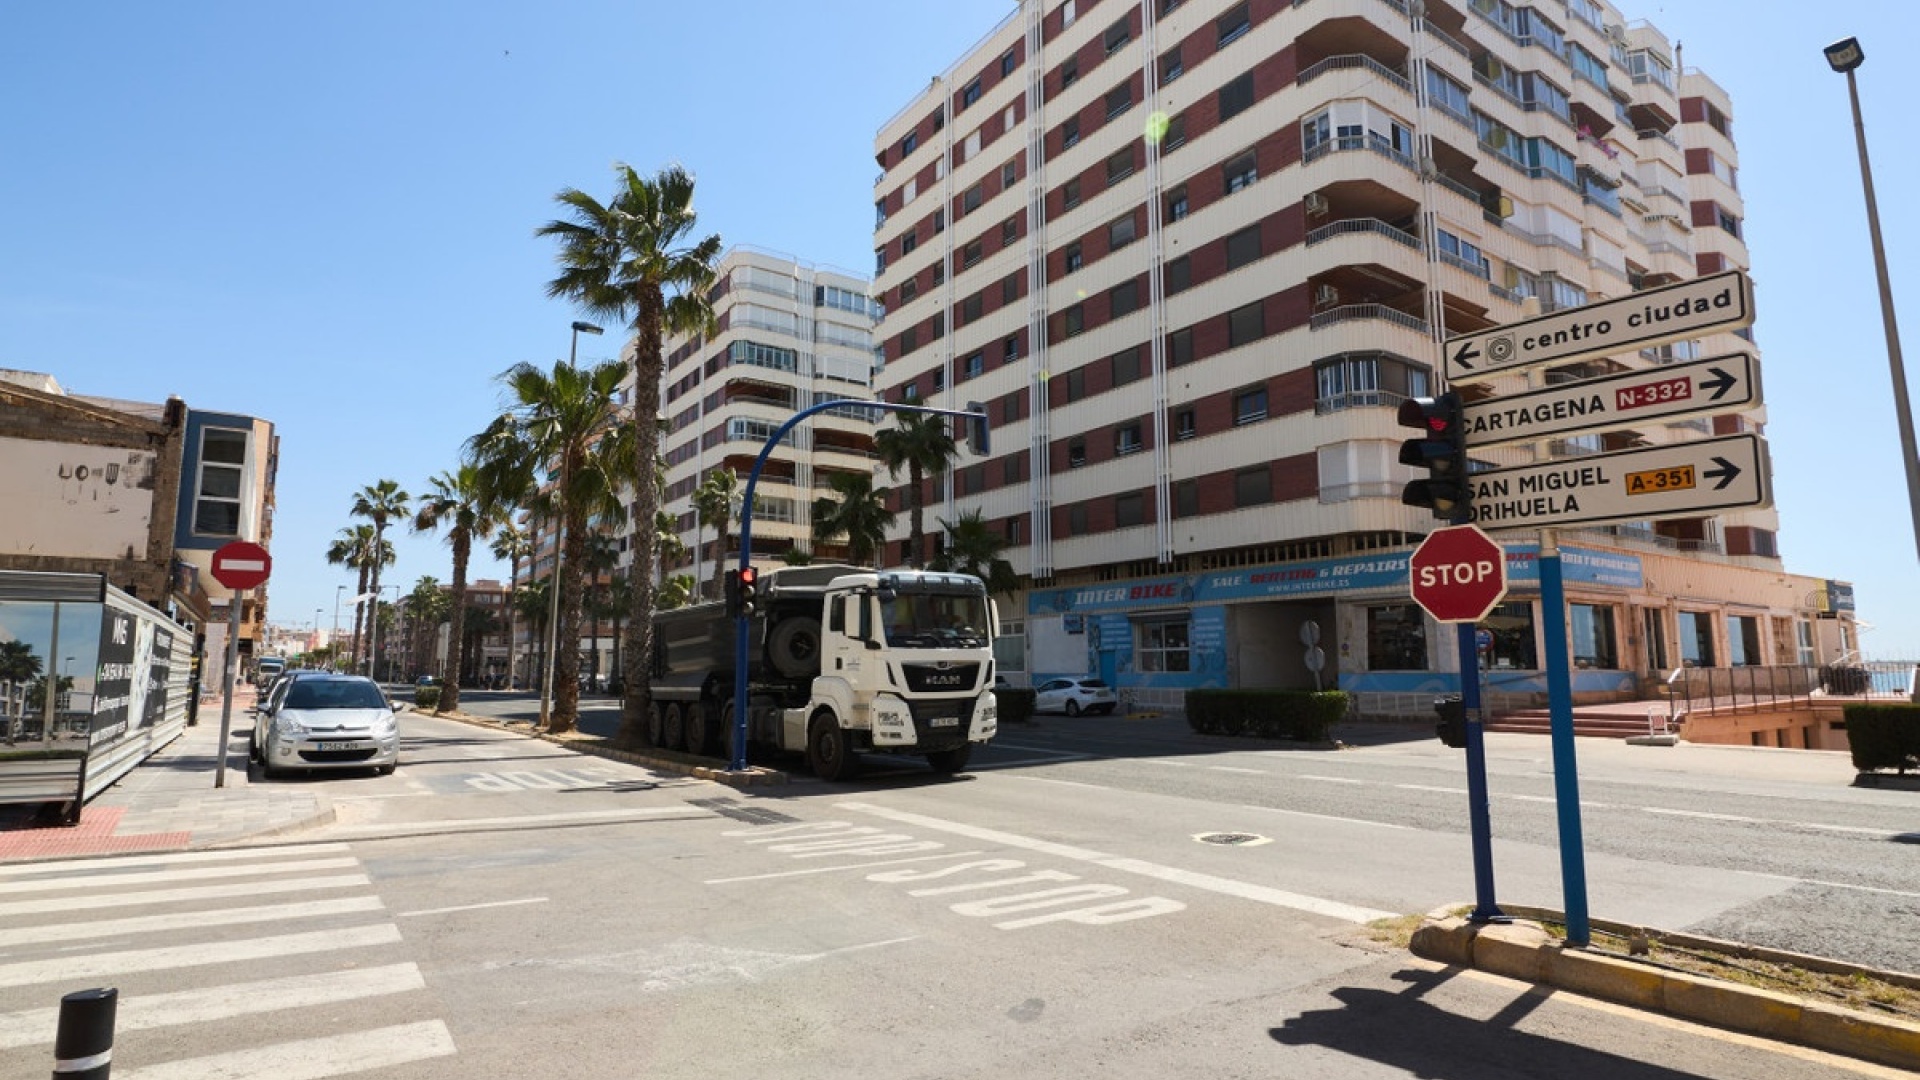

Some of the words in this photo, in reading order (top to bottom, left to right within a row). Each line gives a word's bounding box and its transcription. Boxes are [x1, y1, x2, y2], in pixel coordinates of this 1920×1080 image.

[1523, 321, 1611, 350] centro
[1628, 289, 1732, 327] ciudad
[1464, 395, 1605, 434] CARTAGENA
[1620, 381, 1688, 407] N-332
[1468, 479, 1509, 500] SAN
[1519, 467, 1610, 494] MIGUEL
[1632, 470, 1693, 490] A-351
[1469, 495, 1580, 522] ORIHUELA
[1212, 576, 1242, 588] SALE
[1332, 559, 1407, 576] REPAIRS
[1420, 561, 1494, 587] STOP
[1074, 588, 1127, 605] INTER
[1130, 582, 1178, 600] BIKE
[925, 675, 960, 685] MAN
[720, 821, 945, 858] STOP
[866, 859, 1187, 929] STOP
